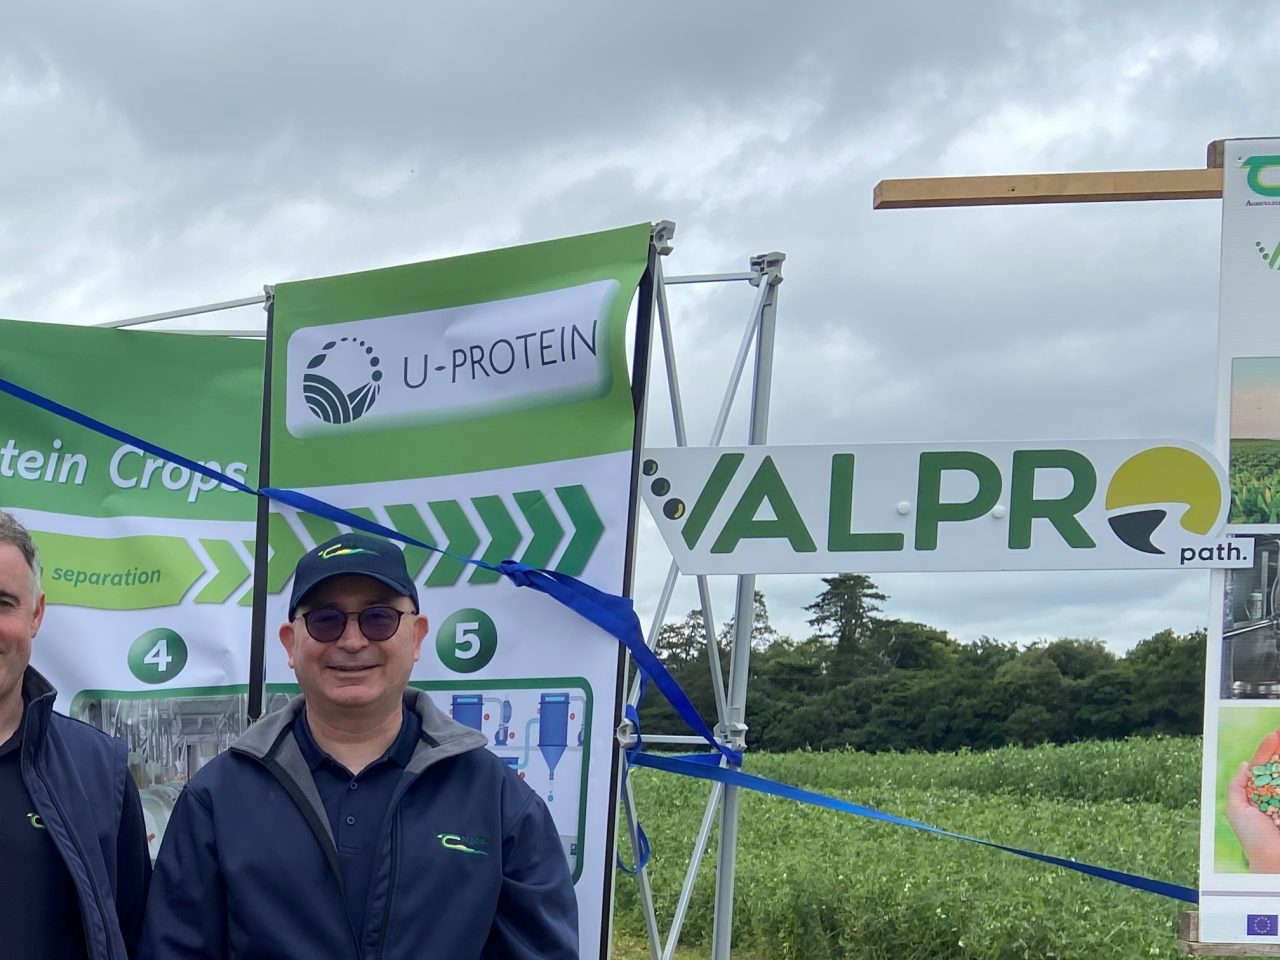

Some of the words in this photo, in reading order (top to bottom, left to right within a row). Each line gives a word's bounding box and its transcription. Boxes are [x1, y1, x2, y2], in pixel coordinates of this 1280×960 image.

[402, 319, 598, 389] U-PROTEIN
[109, 443, 248, 502] Crops
[1180, 538, 1248, 565] path.
[51, 566, 162, 588] separation
[143, 639, 172, 672] 4
[454, 622, 481, 659] 5
